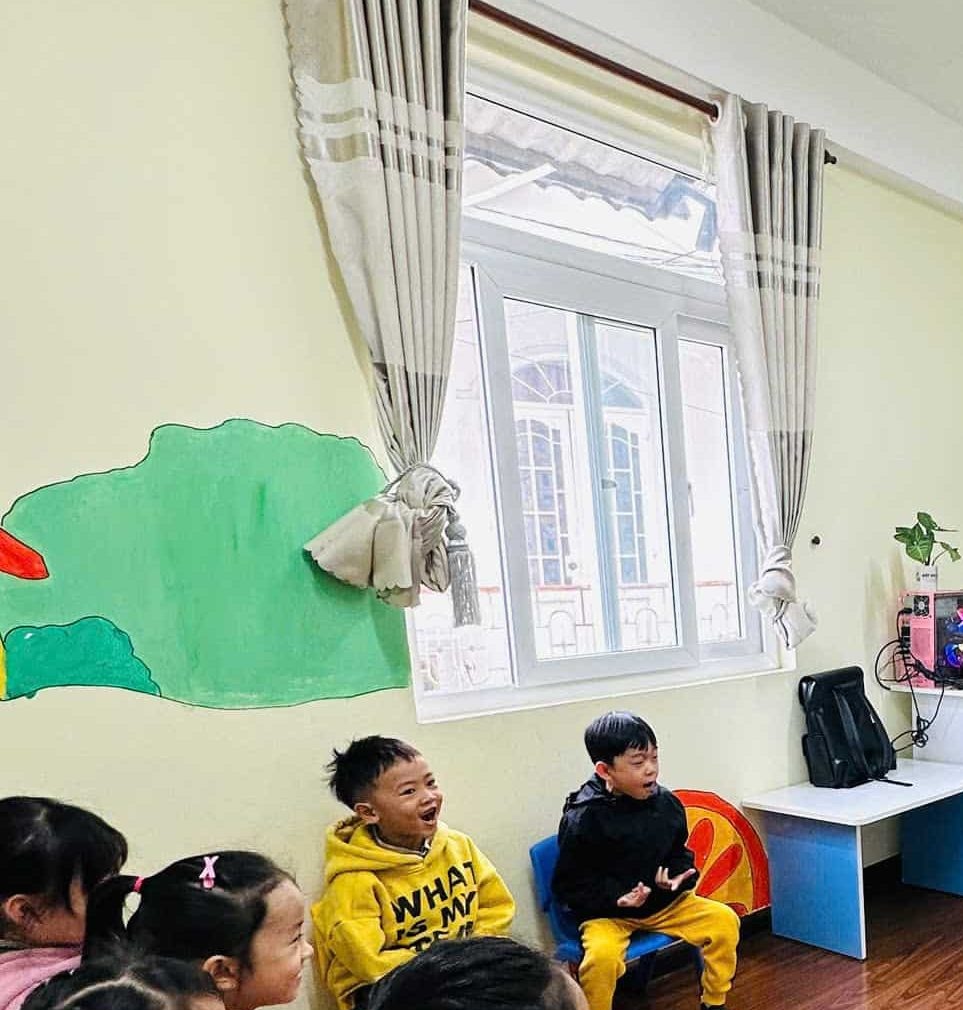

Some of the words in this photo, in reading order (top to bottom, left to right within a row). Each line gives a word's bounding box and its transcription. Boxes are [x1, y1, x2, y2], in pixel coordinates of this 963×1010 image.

[391, 861, 477, 924] WHAT
[397, 918, 428, 941] IS
[440, 891, 476, 929] MY
